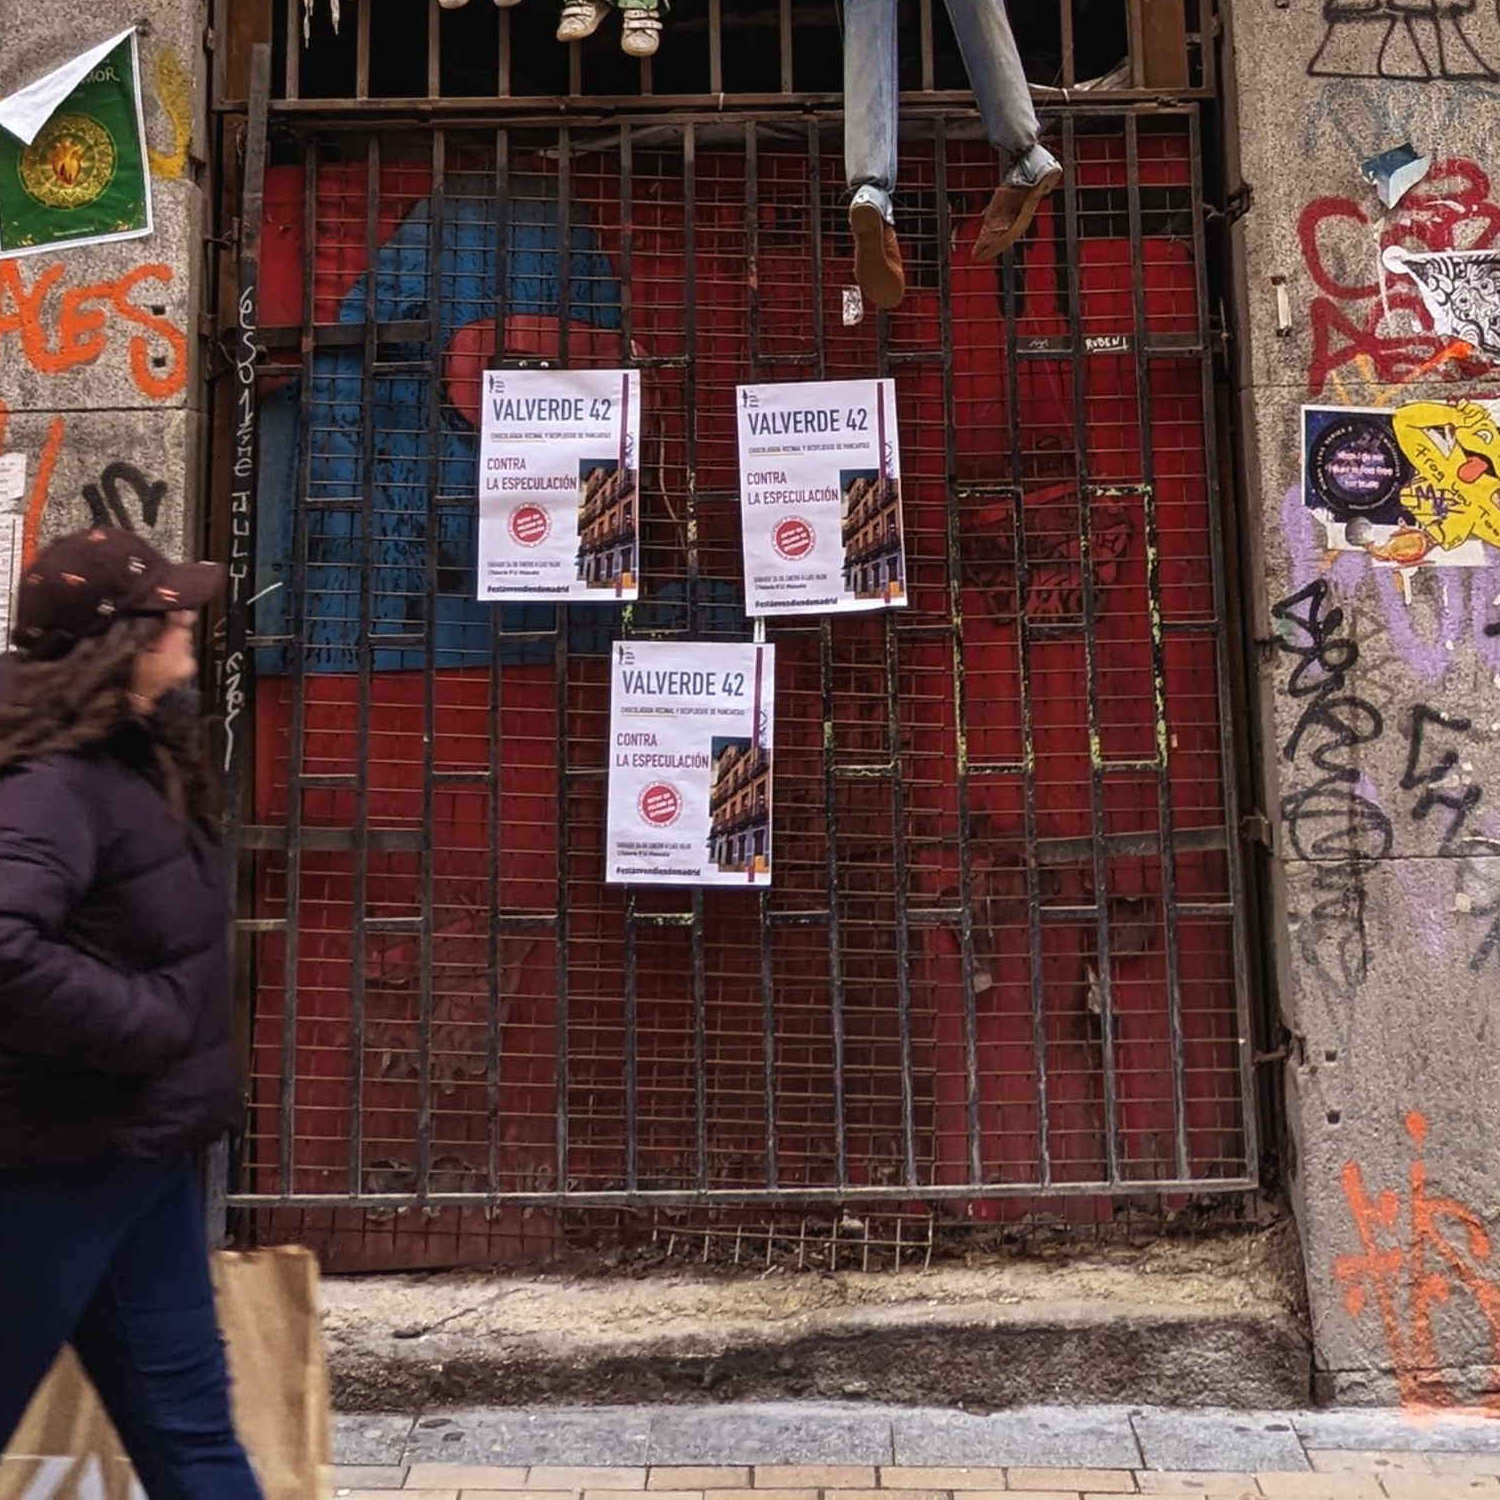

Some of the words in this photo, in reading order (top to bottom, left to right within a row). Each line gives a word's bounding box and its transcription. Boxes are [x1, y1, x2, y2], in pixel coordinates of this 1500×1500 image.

[493, 398, 584, 421] VALVERDE
[589, 399, 611, 421] 42
[748, 409, 840, 436] VALVERDE
[846, 408, 868, 431] 42
[487, 457, 526, 470] CONTRA
[487, 477, 500, 490] LA
[502, 474, 577, 490] ESPECULACIÓN
[747, 471, 787, 485] CONTRA
[747, 492, 762, 505] LA
[763, 486, 838, 505] ESPECULACIÓN
[622, 670, 716, 696] VALVERDE
[721, 672, 744, 696] 42
[617, 733, 657, 746] CONTRA
[616, 754, 629, 767] LA
[632, 752, 709, 769] ESPECULACIÓN
